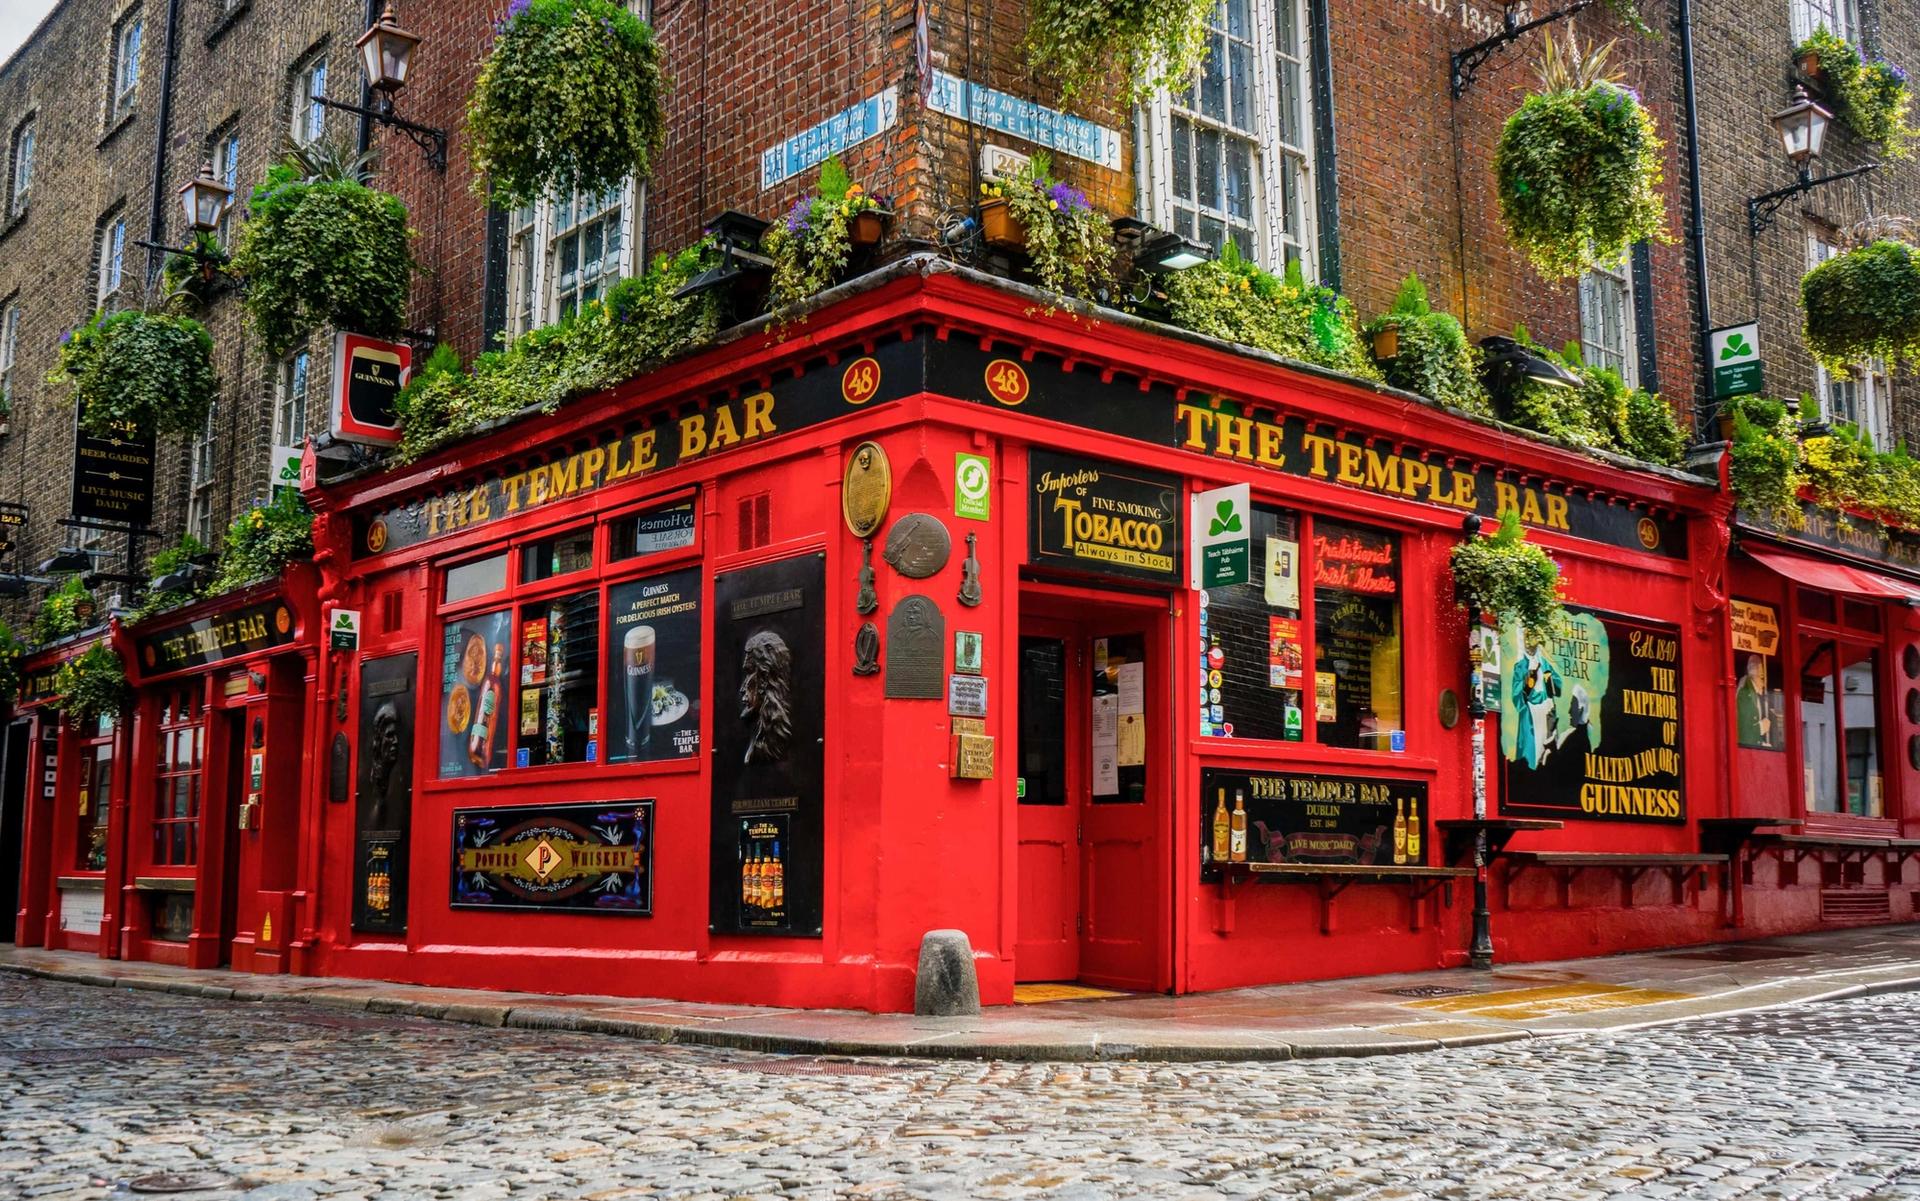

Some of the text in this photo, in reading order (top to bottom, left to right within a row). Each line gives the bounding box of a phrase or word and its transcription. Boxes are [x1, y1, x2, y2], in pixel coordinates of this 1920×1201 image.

[884, 100, 893, 120] 2
[1000, 99, 1013, 112] AN
[354, 371, 396, 387] GUINNESS
[848, 361, 874, 396] 48
[992, 365, 1019, 394] 48
[110, 419, 137, 432] AR
[80, 448, 150, 465] BEER GARDEN
[426, 391, 776, 536] THE TEMPLE BAR
[1177, 402, 1570, 531] THE TEMPLE BAR
[81, 485, 145, 501] LIVE MUSIC
[1036, 469, 1099, 497] Importers
[1076, 487, 1087, 497] OF
[95, 499, 129, 511] DAILY
[1092, 496, 1162, 519] FINE SMOKING
[1054, 497, 1163, 552] TOBACCO
[370, 526, 384, 547] 48
[1077, 544, 1172, 569] Always in Stock
[1314, 535, 1392, 564] Traditional
[642, 583, 669, 597] GUINNESS
[628, 609, 656, 622] DELICIOUS
[656, 606, 671, 617] IRISH
[672, 601, 697, 613] OYSTERS
[631, 593, 680, 611] A PERFECT MATCH
[1330, 603, 1365, 624] TEMPLE
[163, 613, 268, 662] THE TEMPLE BAR
[1563, 620, 1588, 641] THE
[1550, 637, 1600, 663] TEMPLE
[1656, 639, 1676, 662] 1840
[1563, 658, 1590, 681] BAR
[1650, 666, 1675, 693] THE
[1623, 689, 1678, 720] EMPEROR
[673, 735, 700, 747] TEMPLE
[1663, 722, 1678, 746] OF
[679, 745, 693, 753] BAR
[1585, 747, 1680, 782] MALTED LIQUORS
[1250, 777, 1391, 805] THE TEMPLE BAR
[1580, 783, 1680, 817] GUINNESS
[1306, 804, 1340, 817] DUBLIN
[1310, 819, 1323, 828] EST.
[1289, 839, 1355, 850] LIVE MUSIC DAILY
[475, 851, 628, 868] POWERS WHISKEY
[538, 846, 551, 872] P
